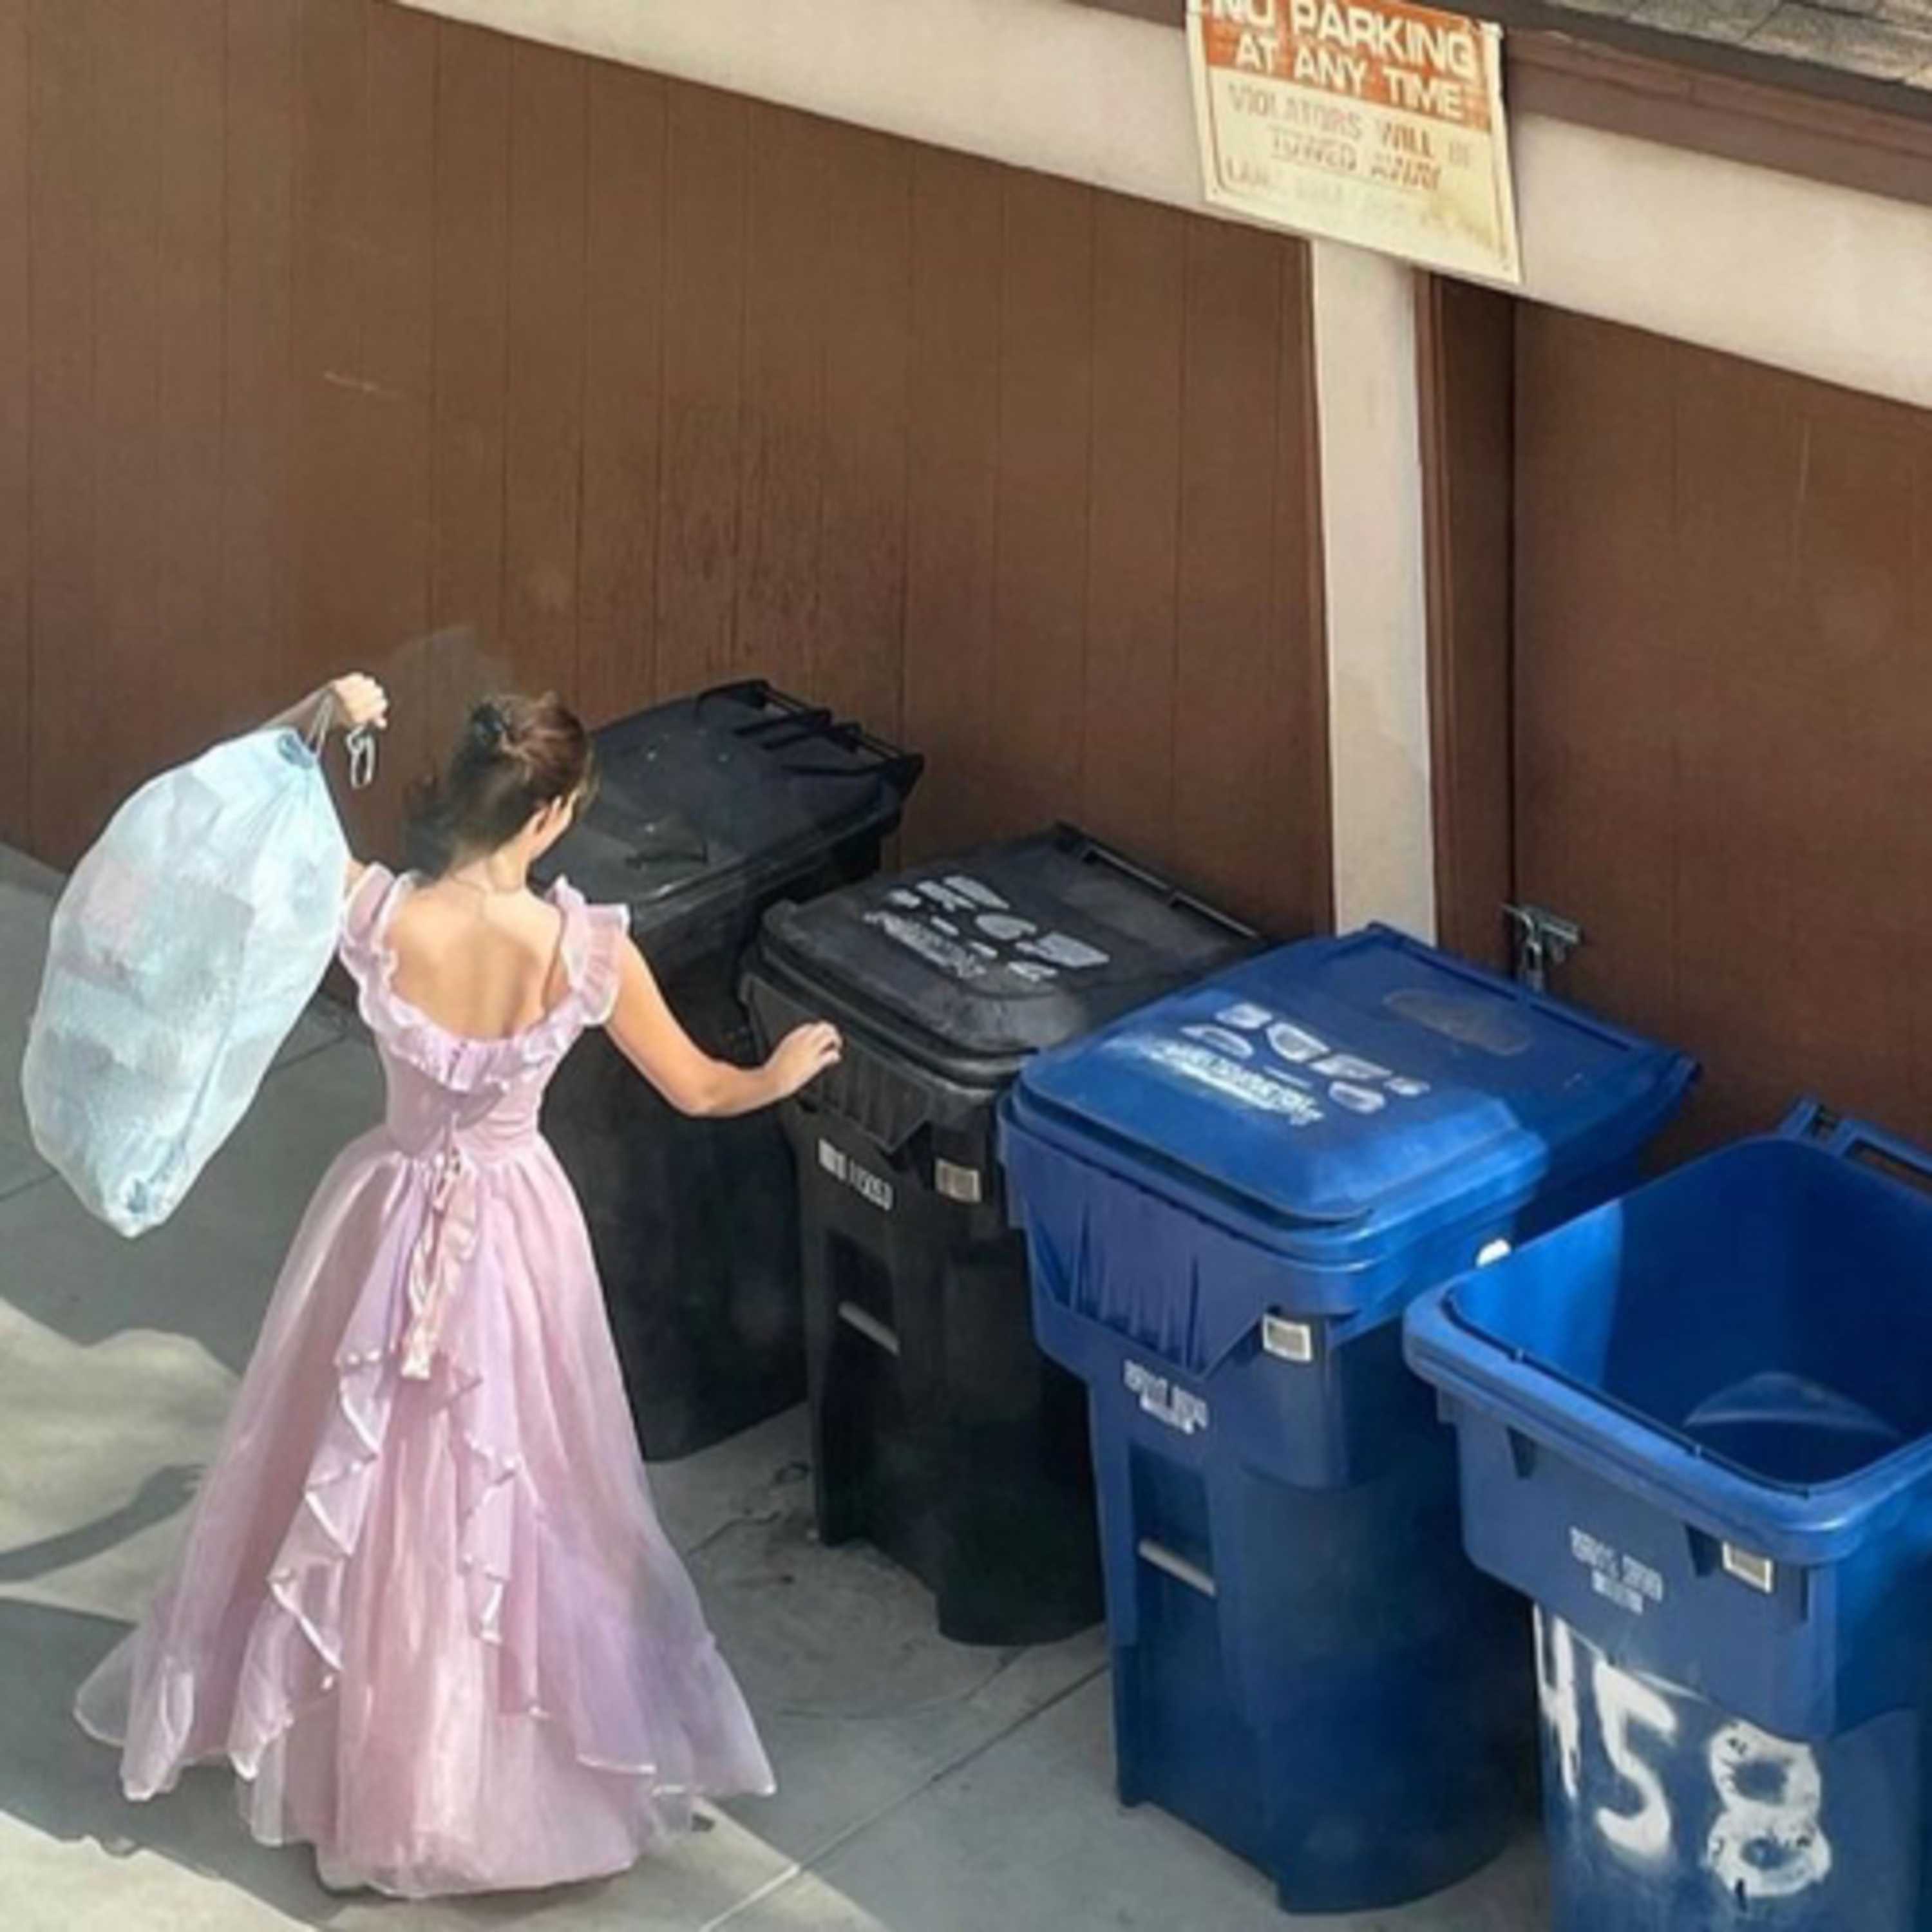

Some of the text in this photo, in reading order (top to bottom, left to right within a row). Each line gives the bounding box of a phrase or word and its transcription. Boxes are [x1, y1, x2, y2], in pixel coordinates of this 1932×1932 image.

[1213, 0, 1477, 80] NO PARKING
[1235, 32, 1279, 75] AT
[1293, 45, 1368, 95] ANY
[1228, 82, 1361, 140] VIOLATORS
[1377, 118, 1435, 159] WILL
